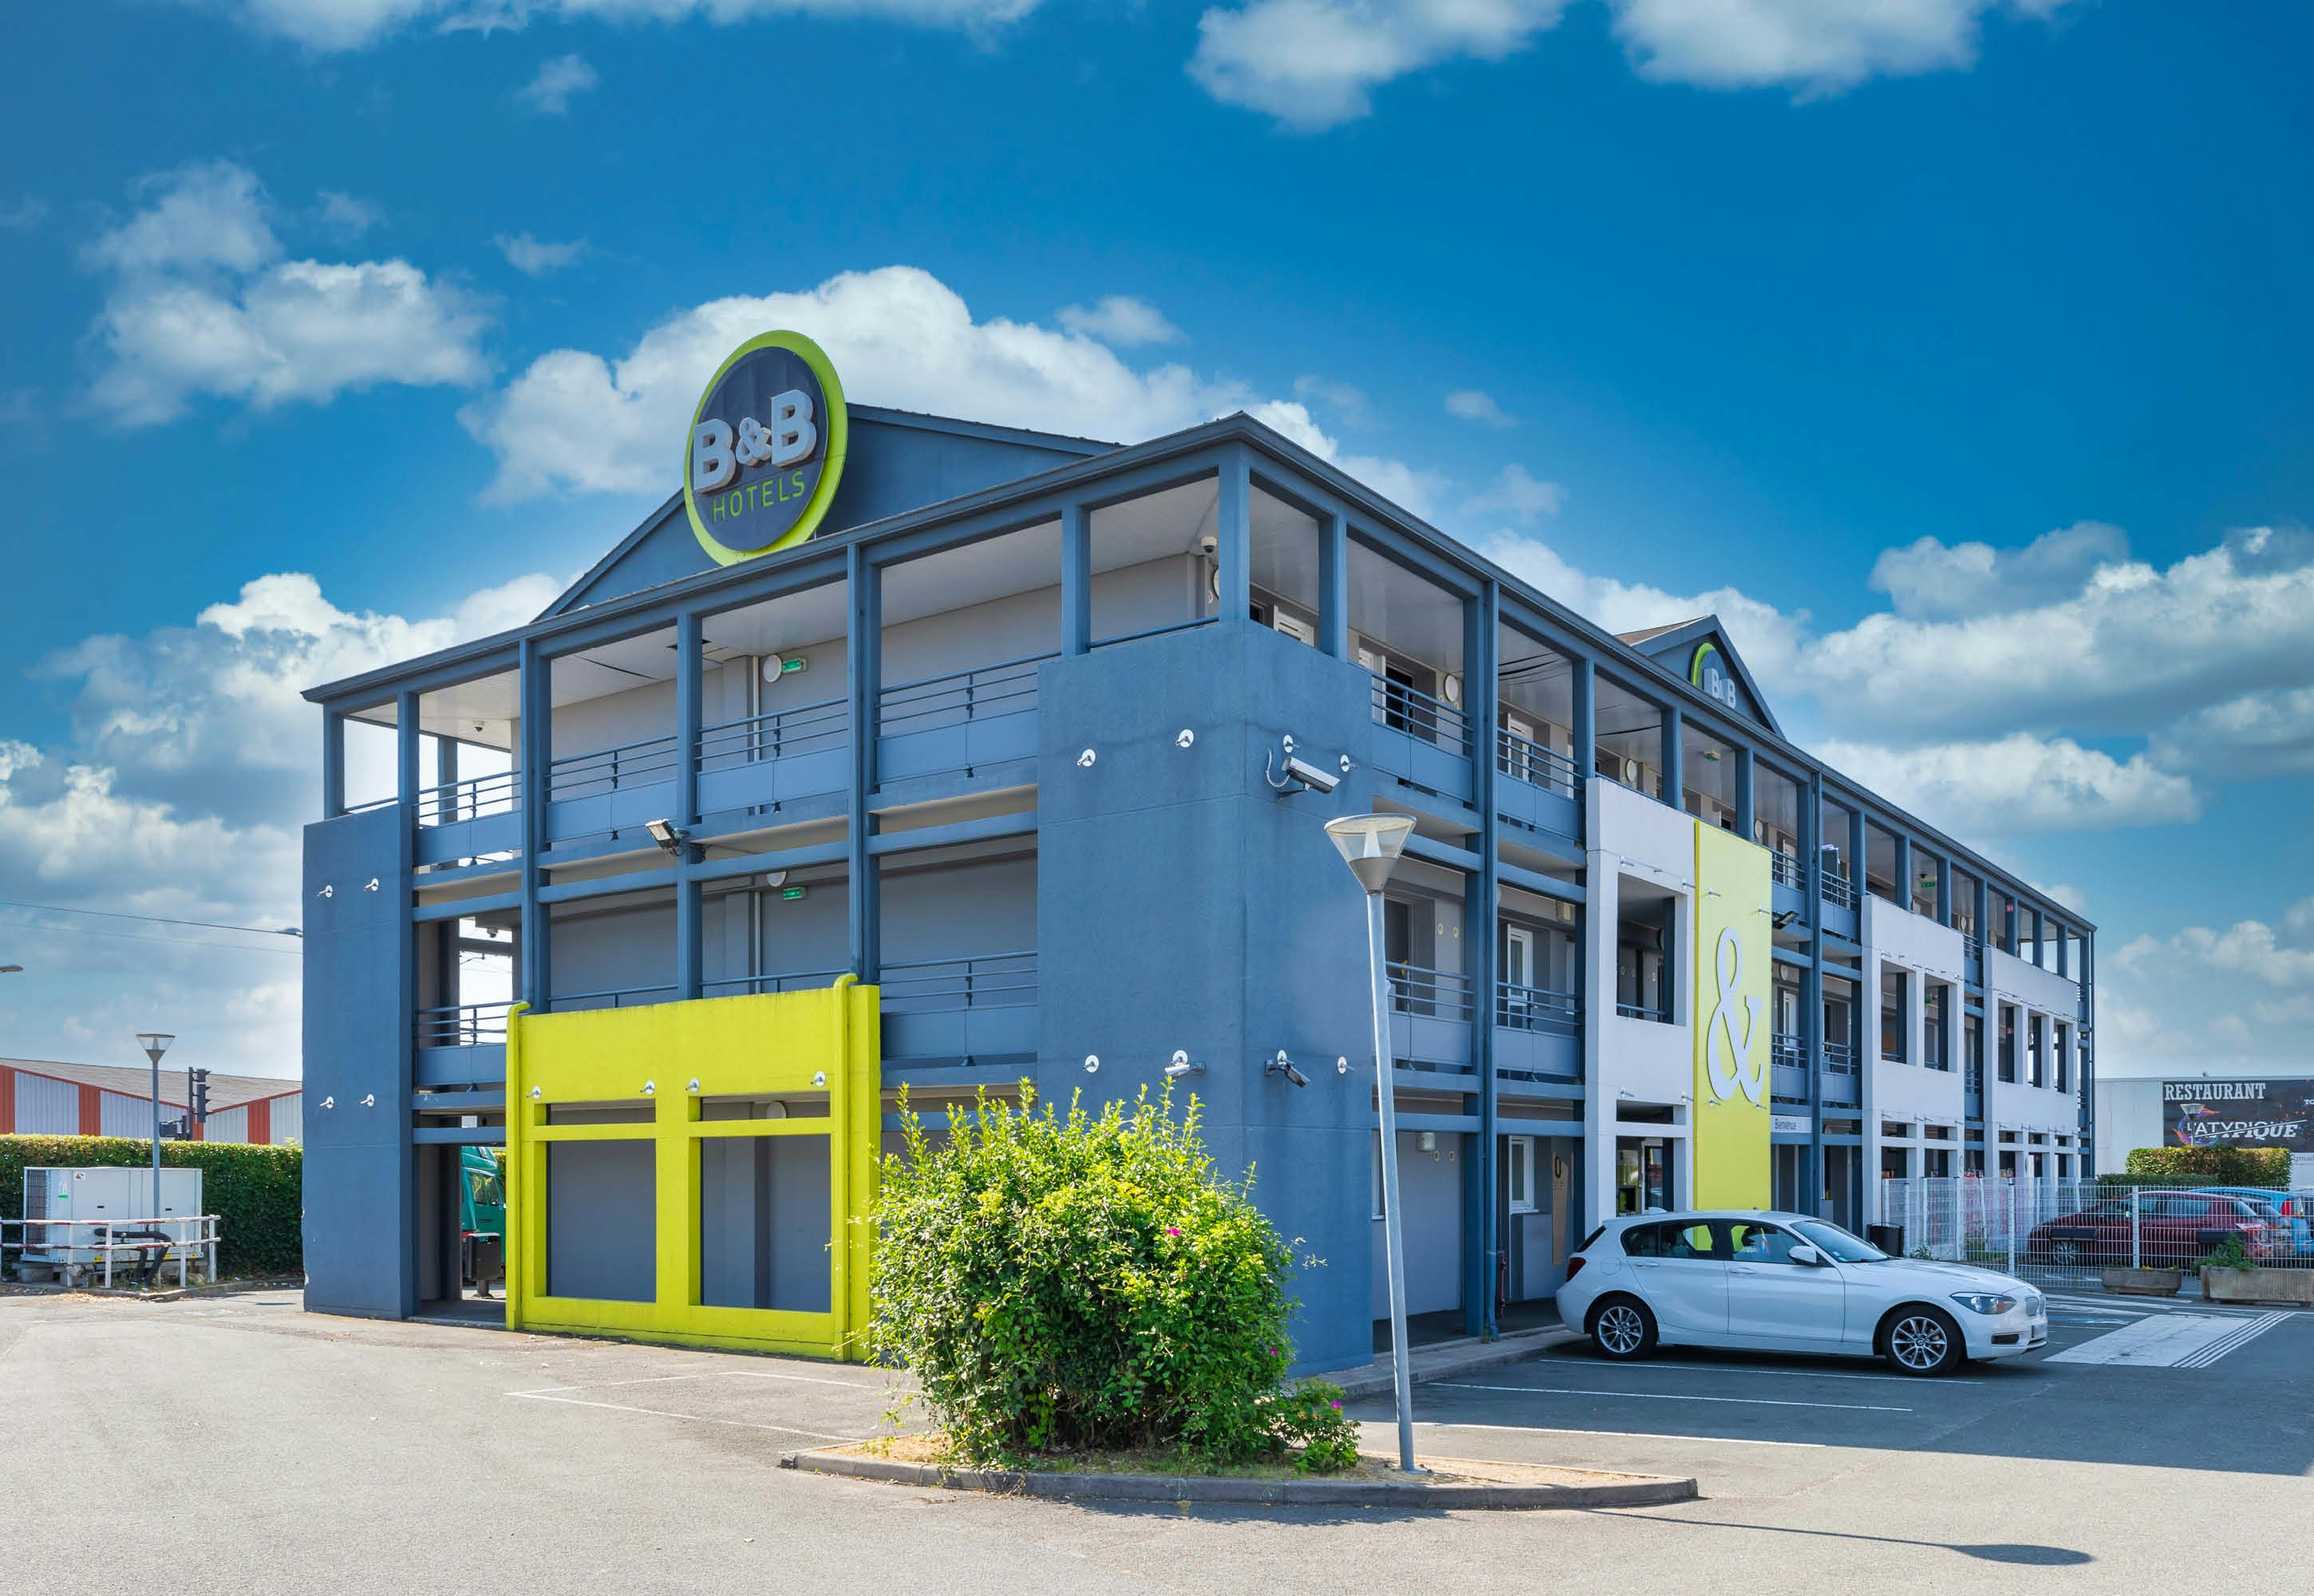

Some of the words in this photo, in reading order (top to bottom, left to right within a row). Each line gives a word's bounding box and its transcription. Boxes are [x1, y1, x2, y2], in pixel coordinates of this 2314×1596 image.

[693, 389, 817, 494] B&B
[711, 470, 805, 523] HOTELS
[2164, 1082, 2266, 1100] RESTAURANT
